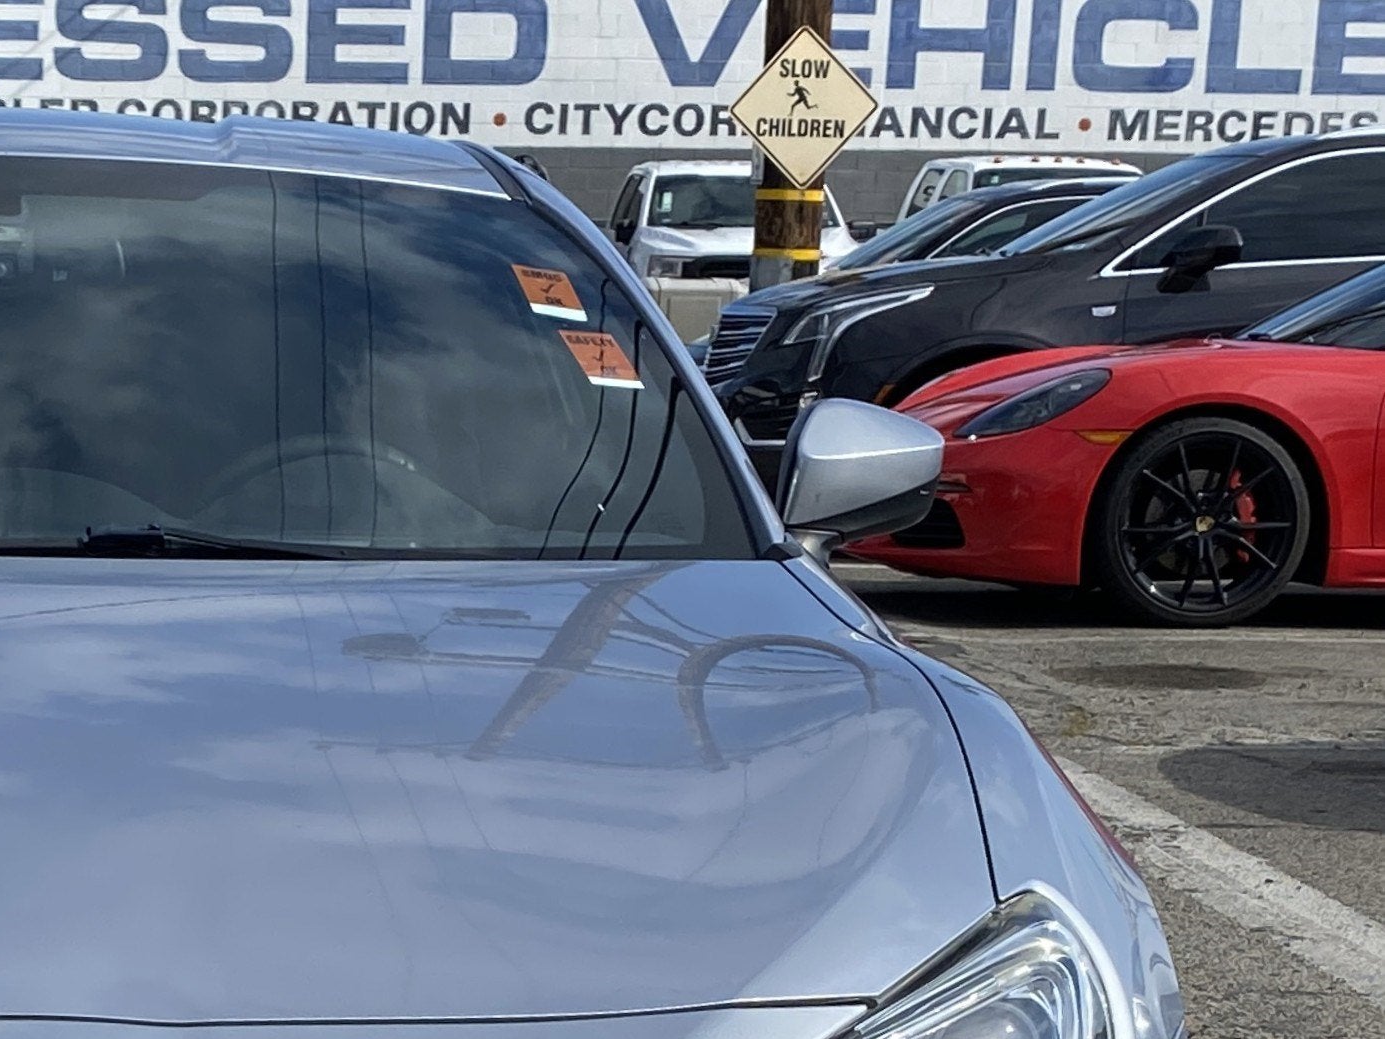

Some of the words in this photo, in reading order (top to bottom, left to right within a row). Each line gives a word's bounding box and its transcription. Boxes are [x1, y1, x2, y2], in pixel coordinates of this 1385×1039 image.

[779, 58, 831, 79] SLOW
[523, 101, 748, 137] CITYCOR
[855, 106, 1060, 140] ANCIAL
[756, 117, 846, 139] CHILDREN
